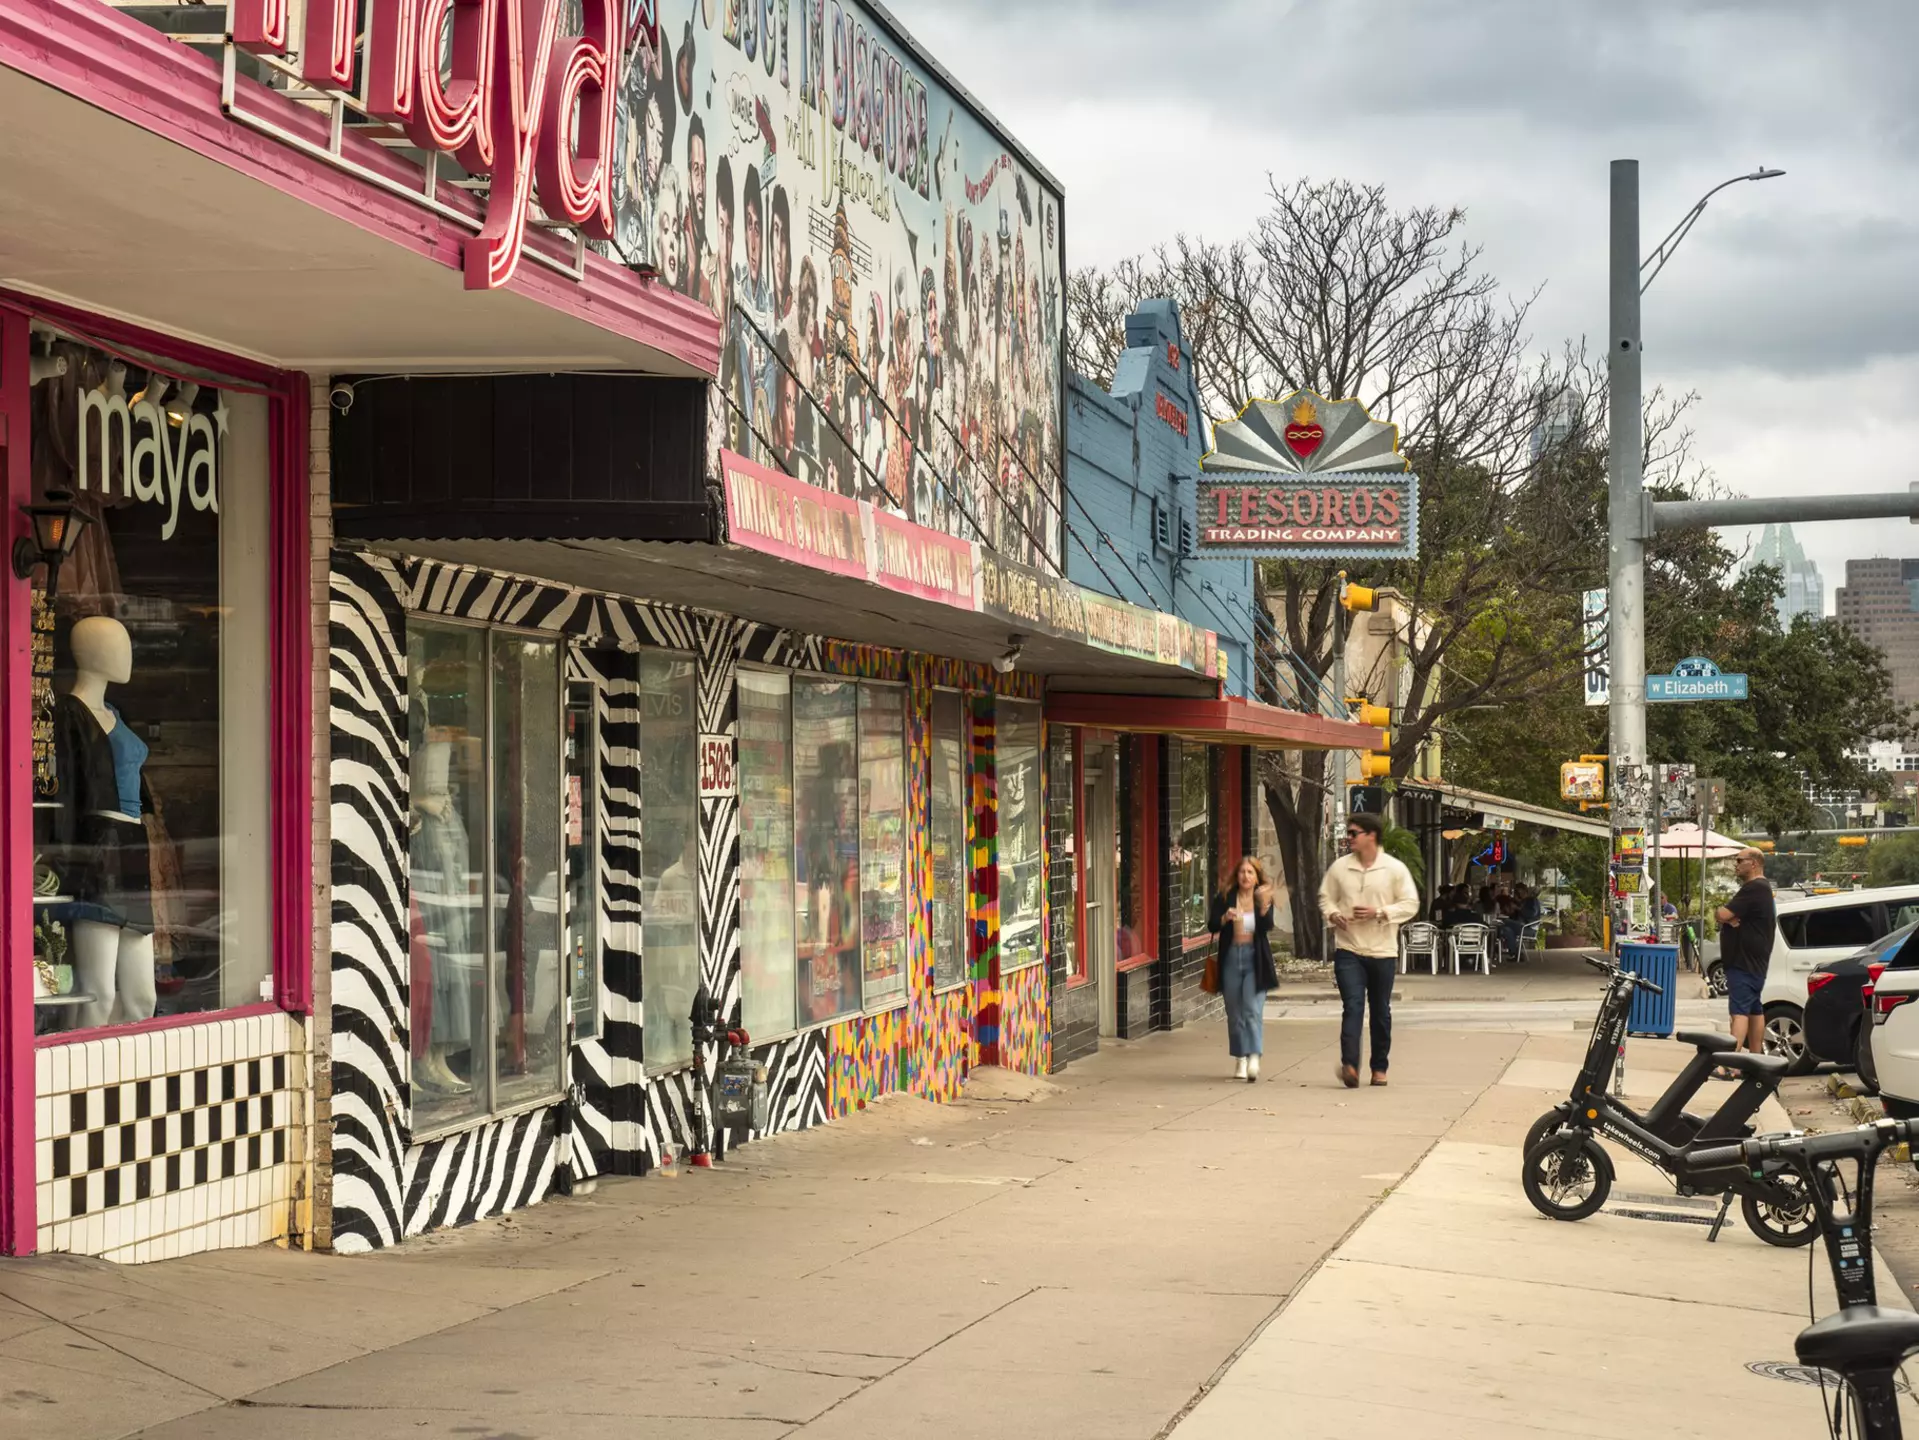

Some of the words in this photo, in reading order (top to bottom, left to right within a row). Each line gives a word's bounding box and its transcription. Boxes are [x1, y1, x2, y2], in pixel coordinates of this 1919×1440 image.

[78, 387, 219, 541] maya
[1208, 486, 1400, 526] TESOROS
[1207, 528, 1294, 541] TRADING
[1301, 528, 1398, 541] COMPANY
[1652, 683, 1660, 693] W
[1664, 680, 1728, 695] Elizabeth
[701, 742, 731, 791] 1506
[1403, 790, 1434, 800] ATM
[1610, 1019, 1622, 1045] WHEELS
[1603, 1121, 1661, 1160] takewheels.com
